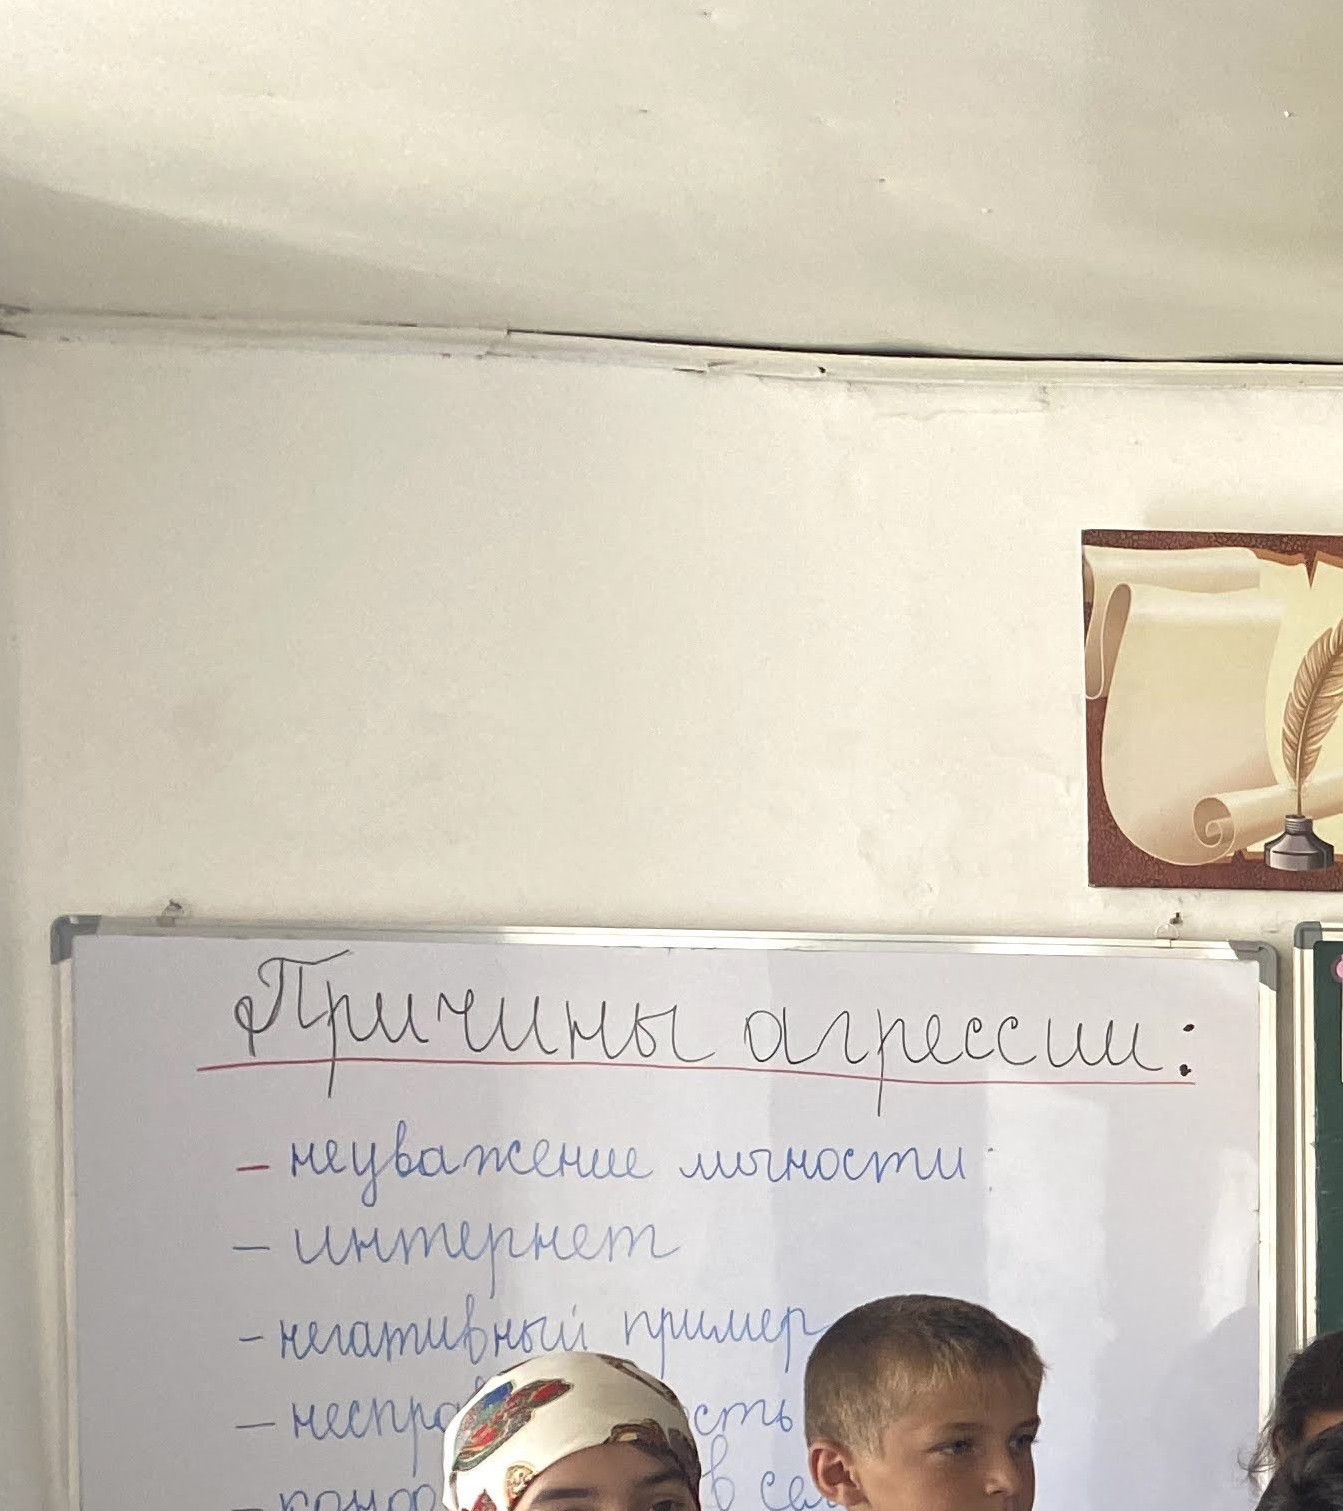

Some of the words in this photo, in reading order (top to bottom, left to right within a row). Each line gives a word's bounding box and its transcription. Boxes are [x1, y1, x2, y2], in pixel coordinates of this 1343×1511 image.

[235, 949, 716, 1098] Причины
[743, 1006, 1196, 1117] агрессии:
[294, 1220, 681, 1299] интернет
